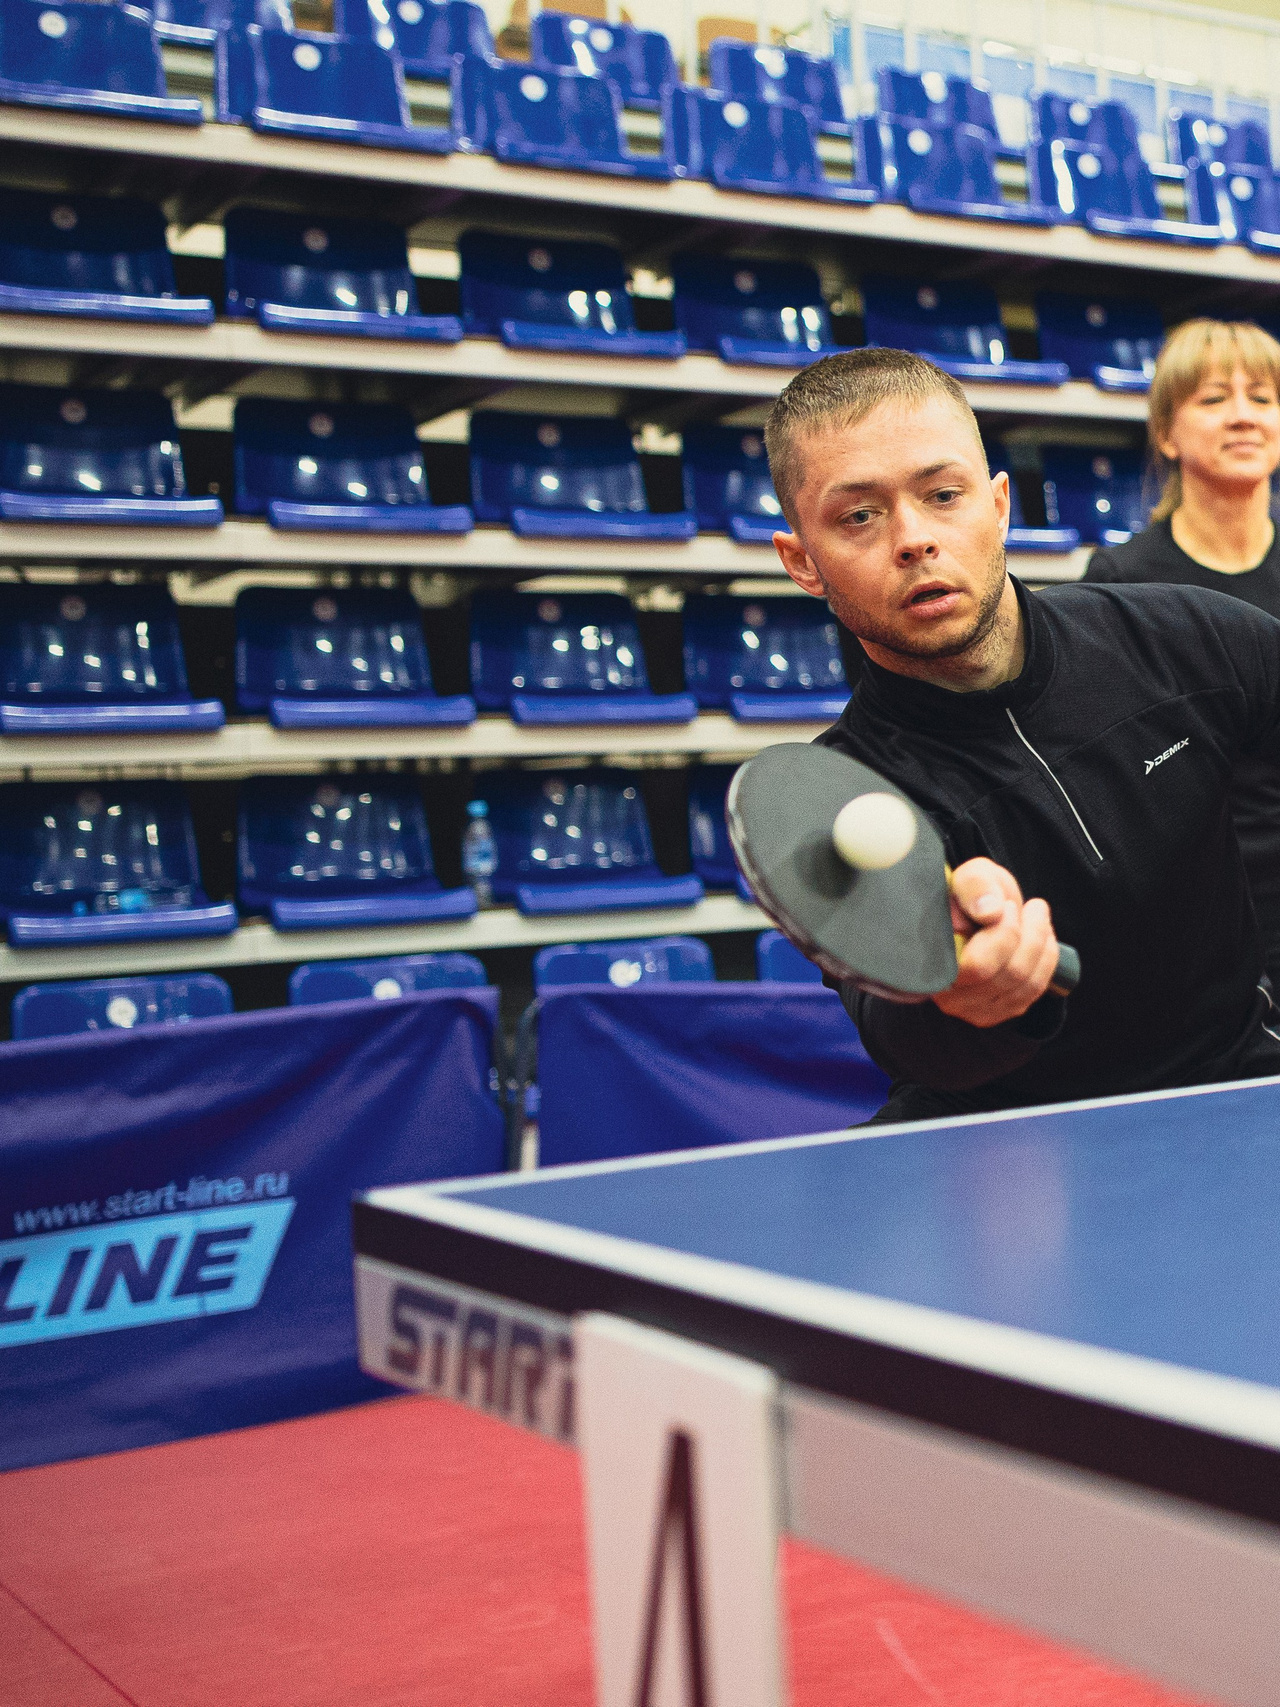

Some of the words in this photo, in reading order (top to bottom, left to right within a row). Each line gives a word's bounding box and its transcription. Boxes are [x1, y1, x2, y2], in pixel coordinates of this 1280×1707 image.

[1153, 737, 1190, 767] DEMIX
[13, 1171, 290, 1234] www.start-line.ru
[0, 1226, 254, 1325] LINE
